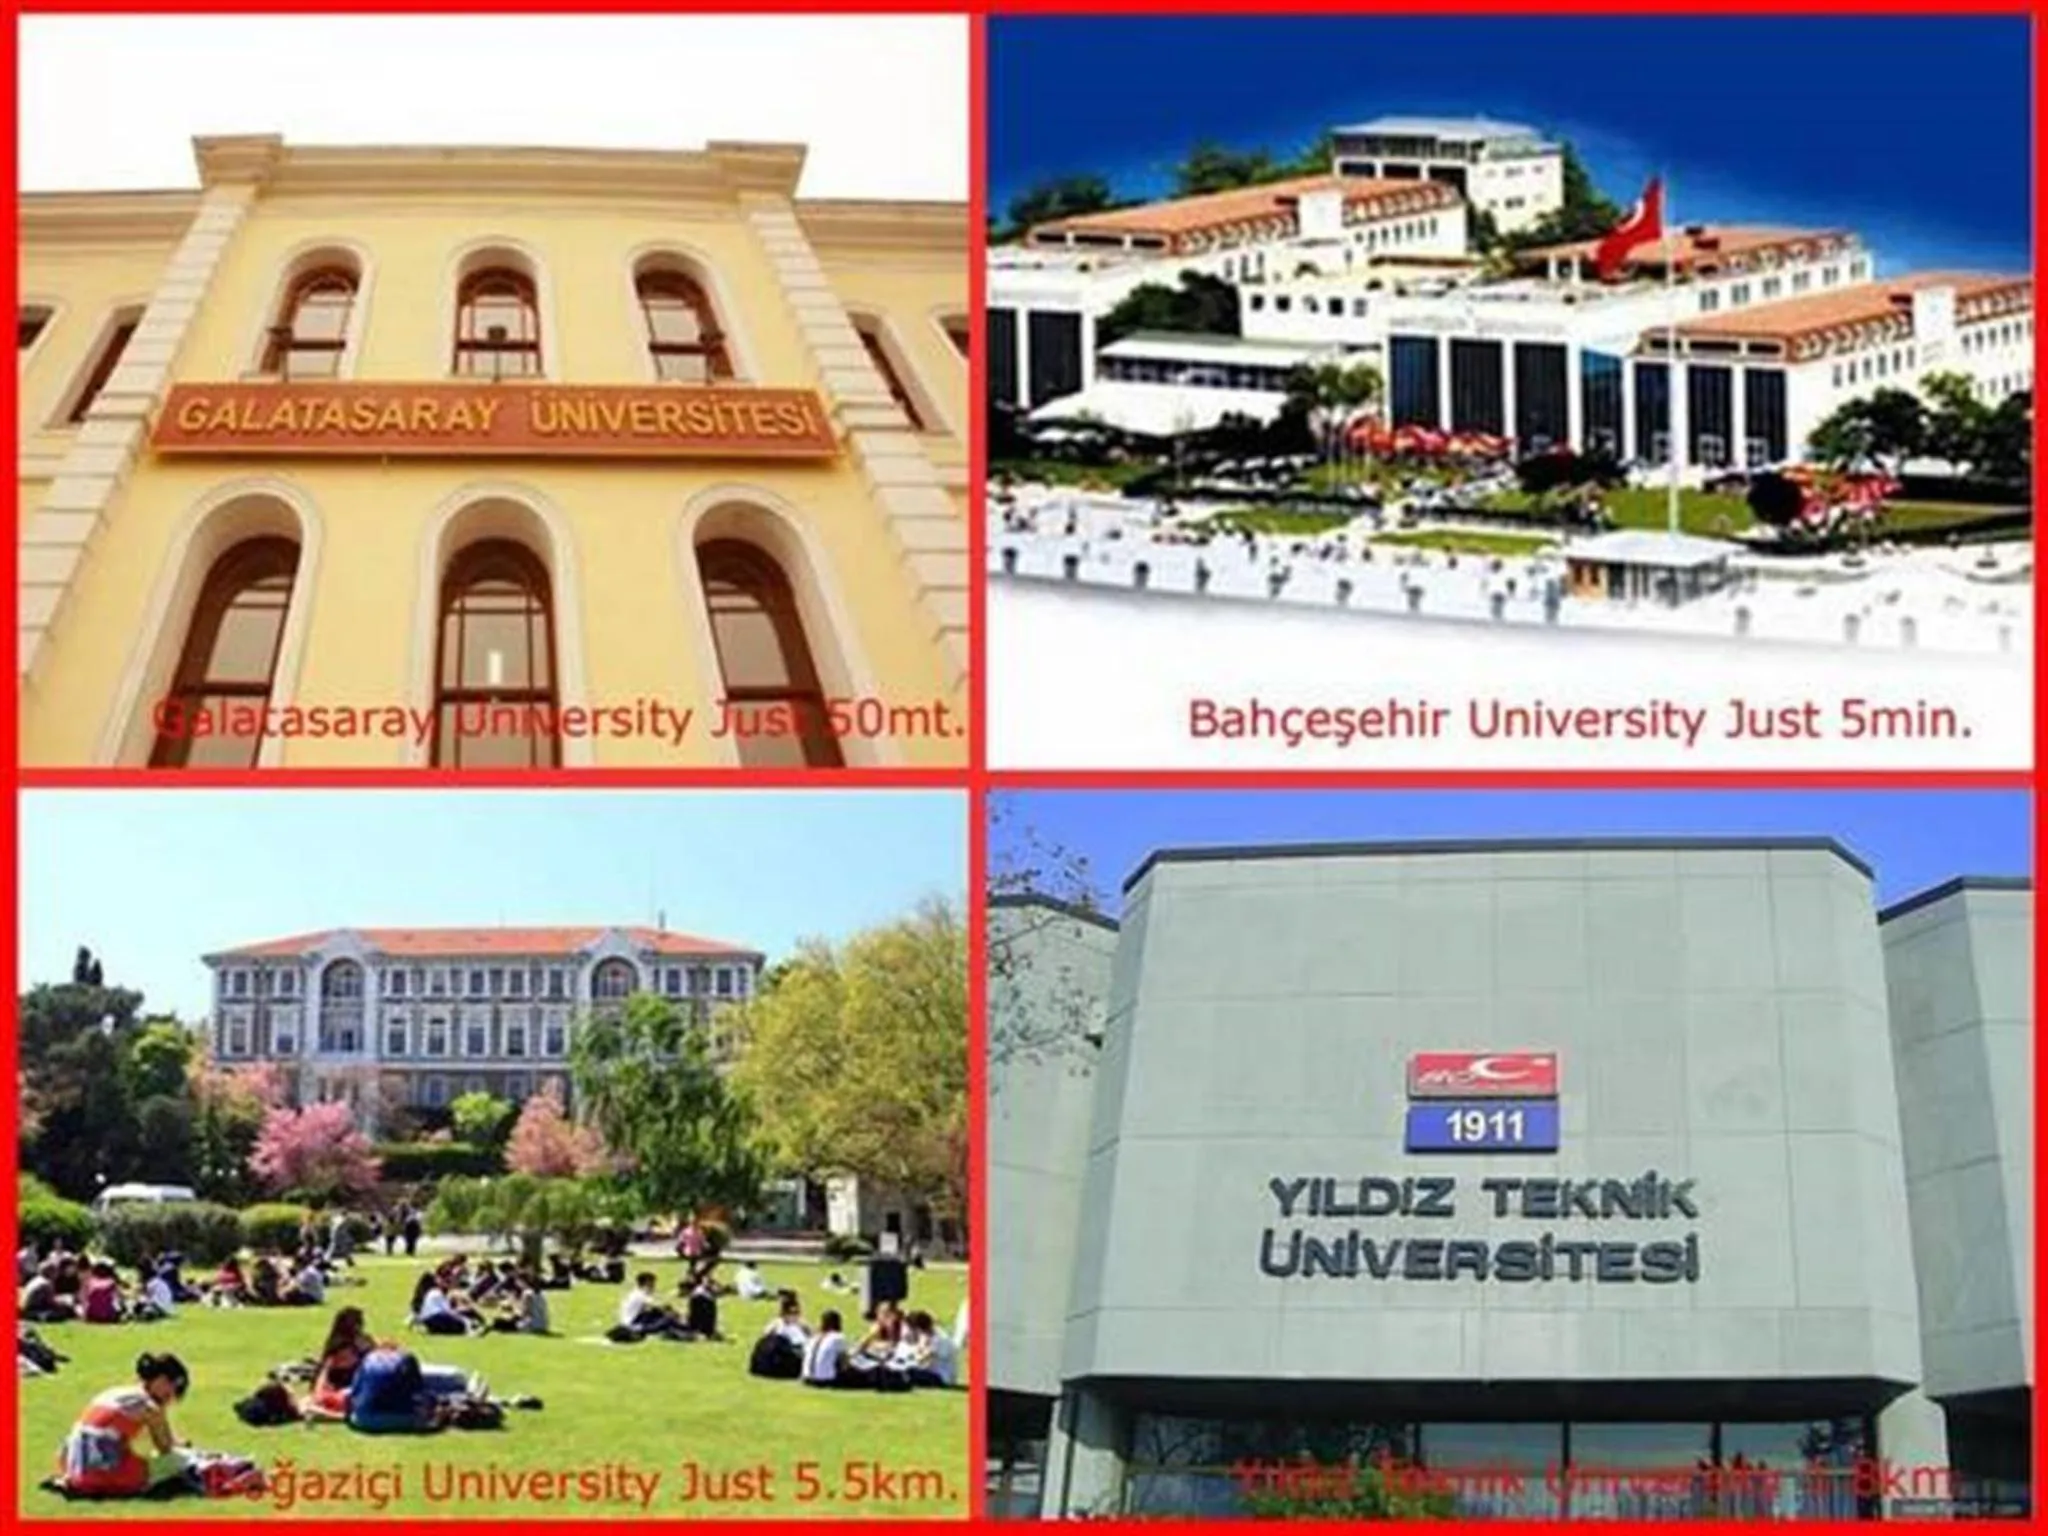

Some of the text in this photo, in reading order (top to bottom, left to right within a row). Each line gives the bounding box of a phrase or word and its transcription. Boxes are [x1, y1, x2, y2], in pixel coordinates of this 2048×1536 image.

[177, 391, 816, 438] GALATASARAY ÜNİVERSİTESİ
[1446, 1109, 1525, 1142] 1911
[1269, 1169, 1699, 1220] YILDIZ TEKNİK
